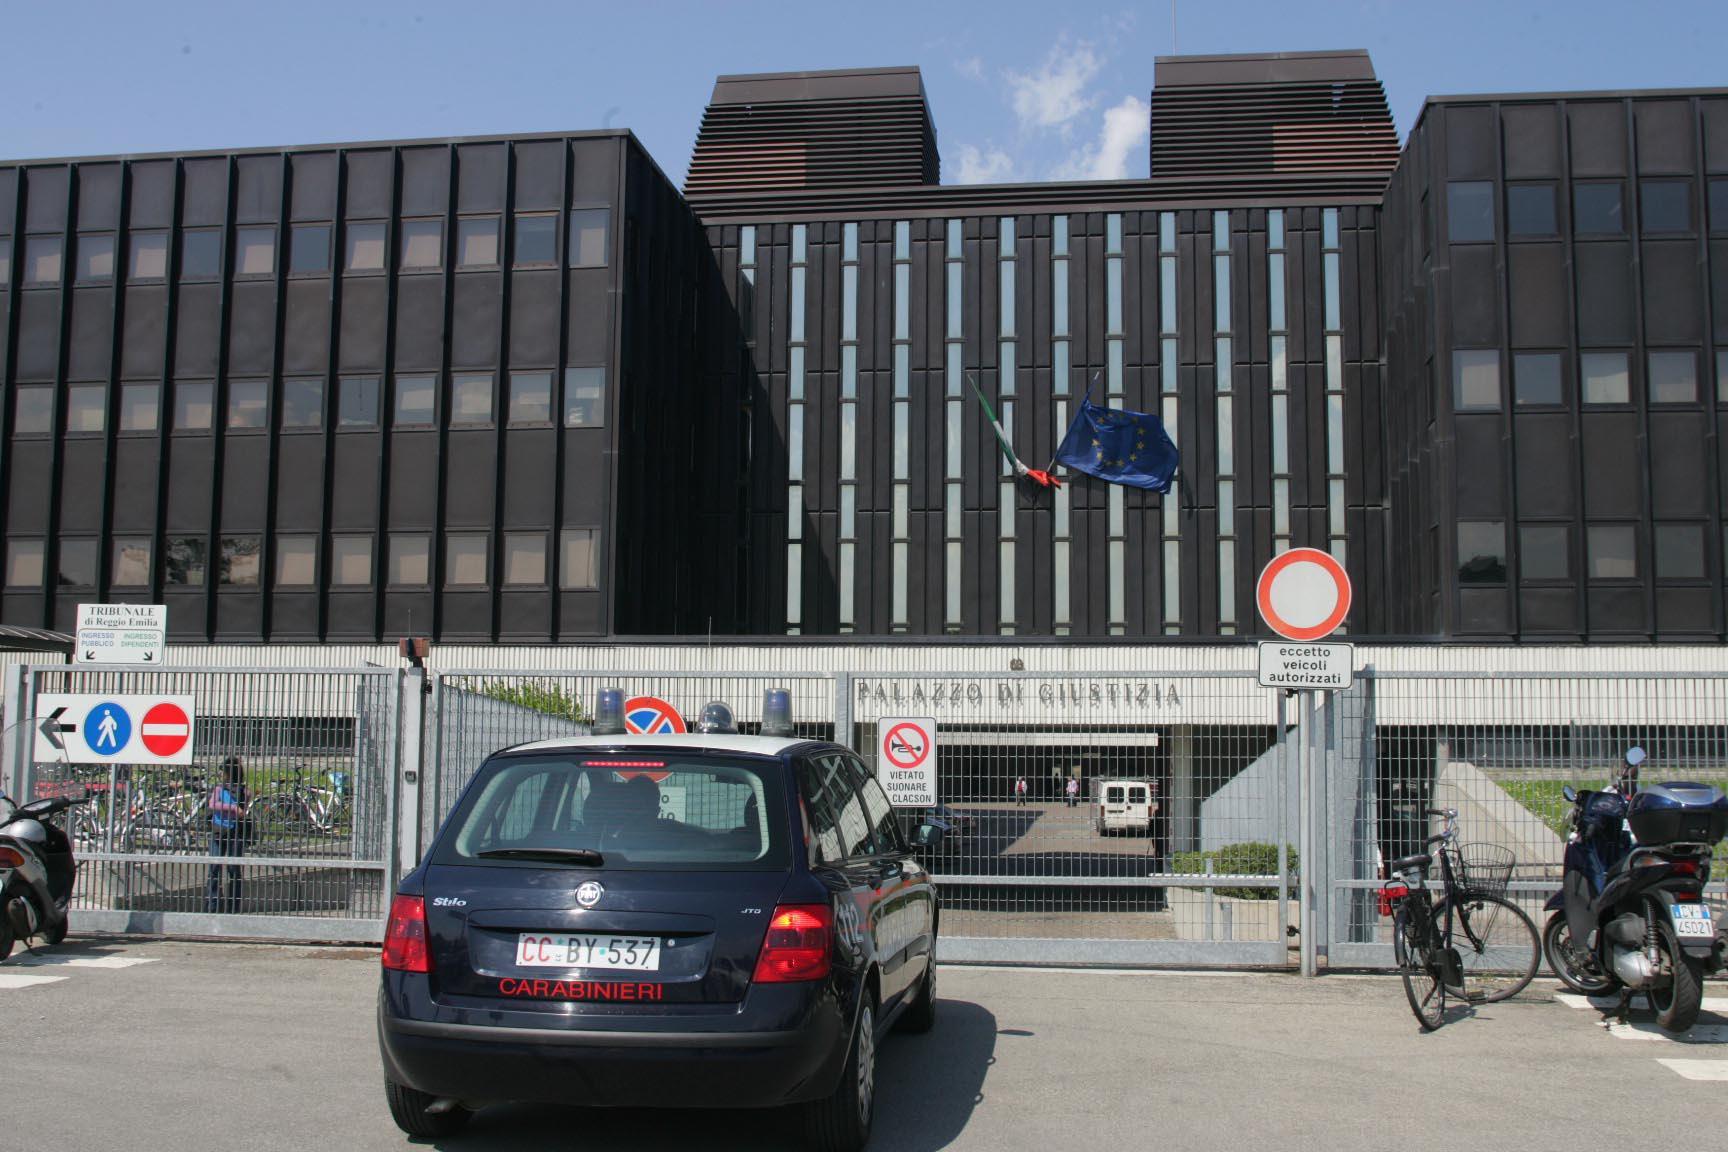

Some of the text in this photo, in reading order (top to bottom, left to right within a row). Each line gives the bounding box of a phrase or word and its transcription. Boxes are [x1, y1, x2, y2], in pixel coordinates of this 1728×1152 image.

[89, 606, 155, 617] TRIBUNALE
[84, 617, 158, 628] di Reggio Emilia
[1279, 647, 1331, 657] eccetto
[1283, 659, 1327, 671] veicoli
[1269, 672, 1341, 684] autorizzati
[858, 682, 1181, 704] PALAZZO DI GIUSTIZIA
[889, 770, 926, 780] VIETATO
[886, 782, 928, 792] SUONARE
[892, 793, 932, 803] CLACSON
[433, 896, 467, 908] Stilo
[522, 936, 656, 966] CC BY 537
[499, 978, 663, 1000] CARABINIERI
